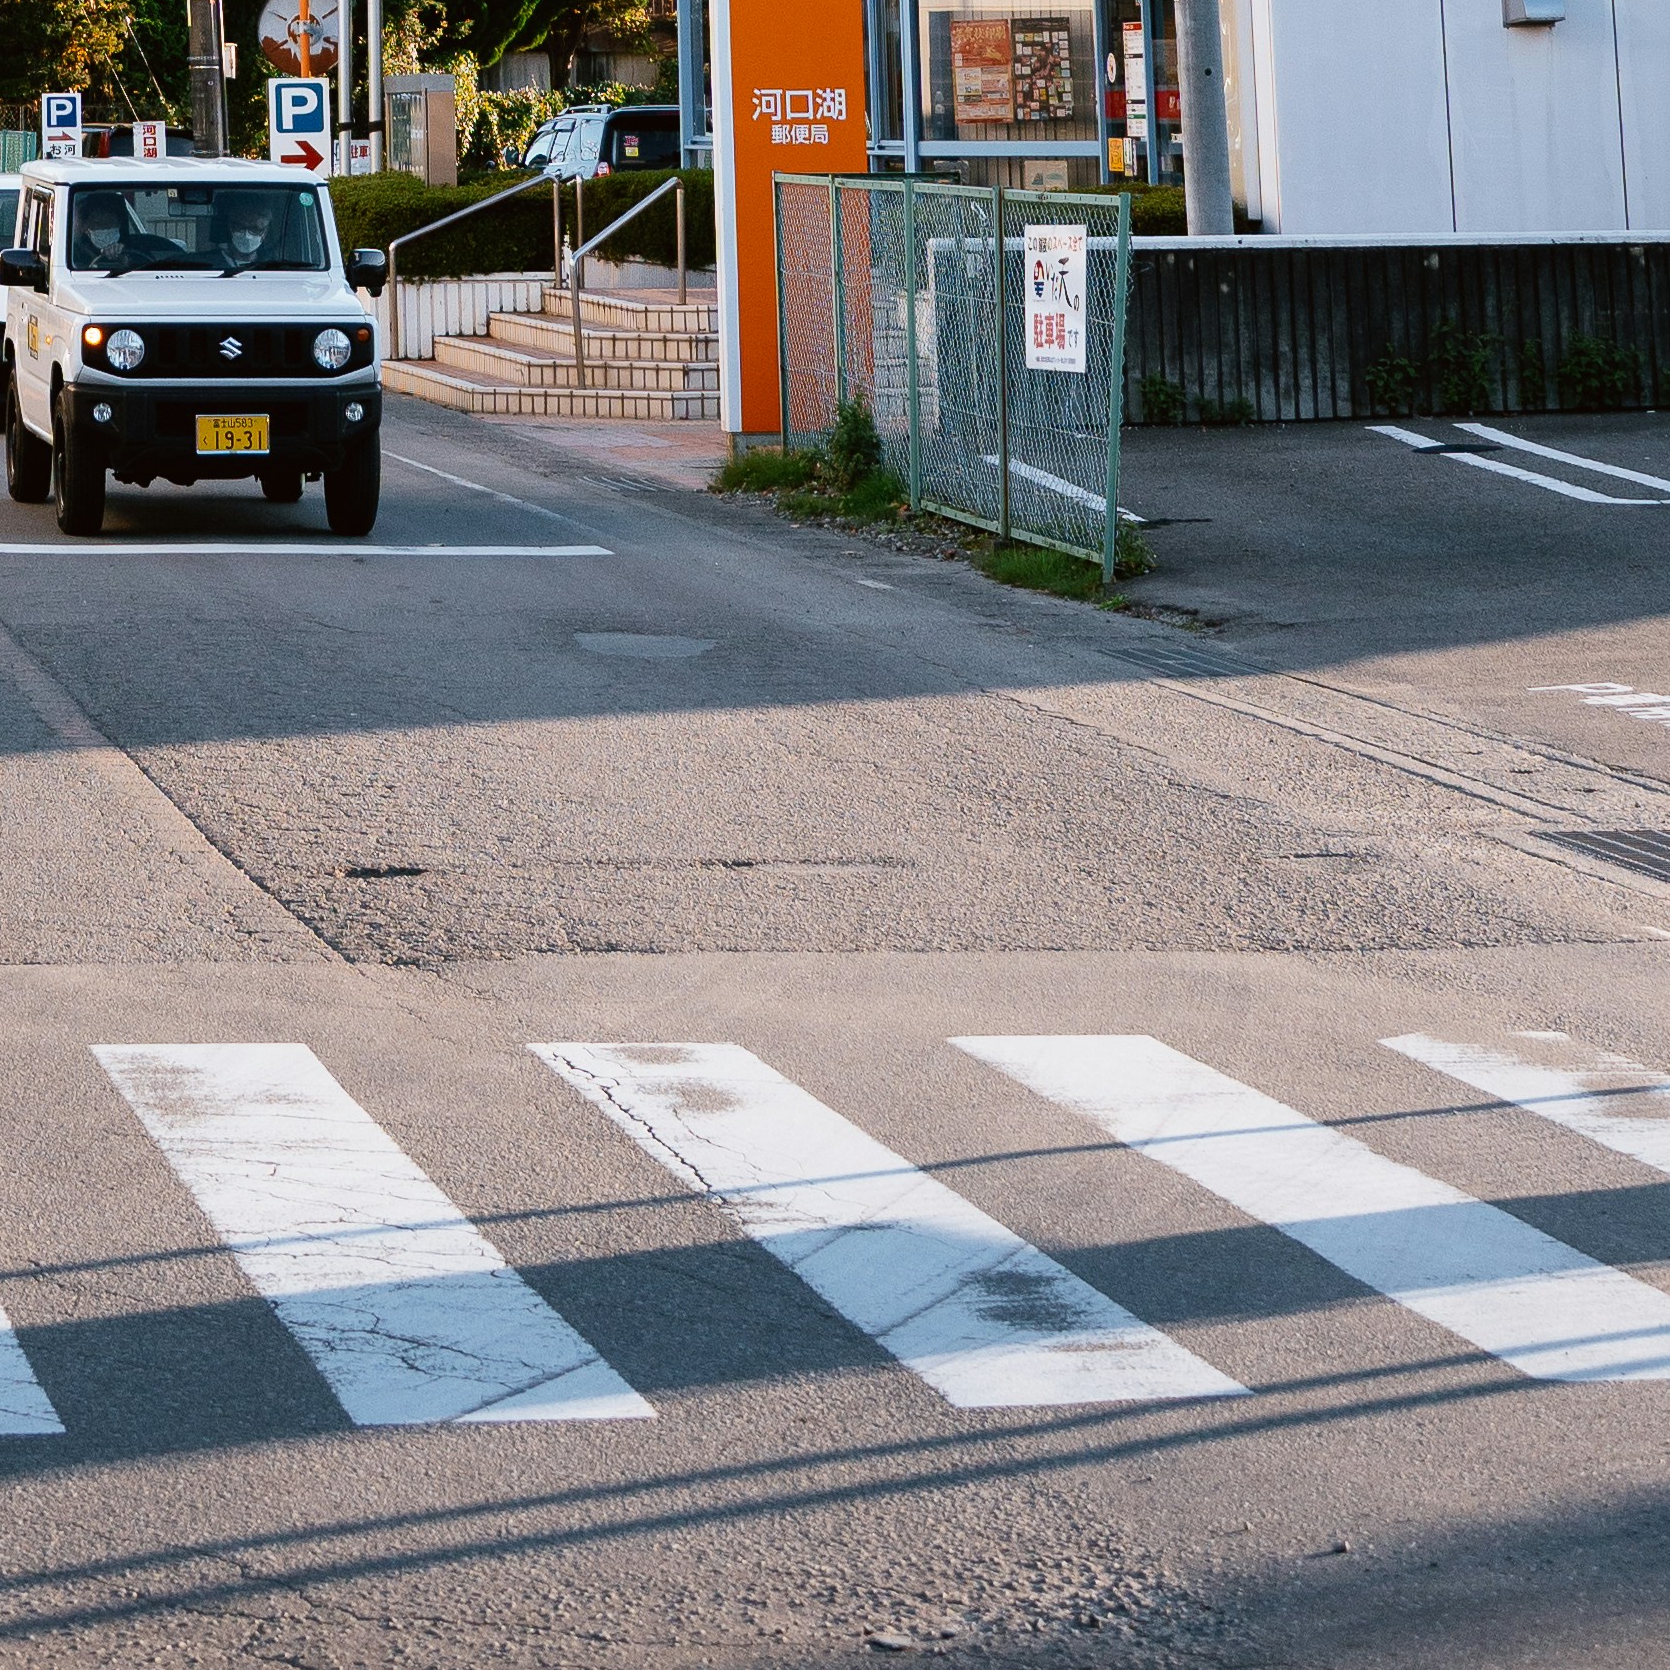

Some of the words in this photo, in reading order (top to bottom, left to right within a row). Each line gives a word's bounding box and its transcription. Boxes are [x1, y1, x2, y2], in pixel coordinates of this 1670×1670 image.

[50, 99, 73, 126] P
[281, 87, 318, 130] P
[752, 88, 847, 121] 河口湖
[142, 124, 158, 158] 河口湖
[771, 124, 829, 145] 郵便局
[215, 430, 263, 450] 19-31
